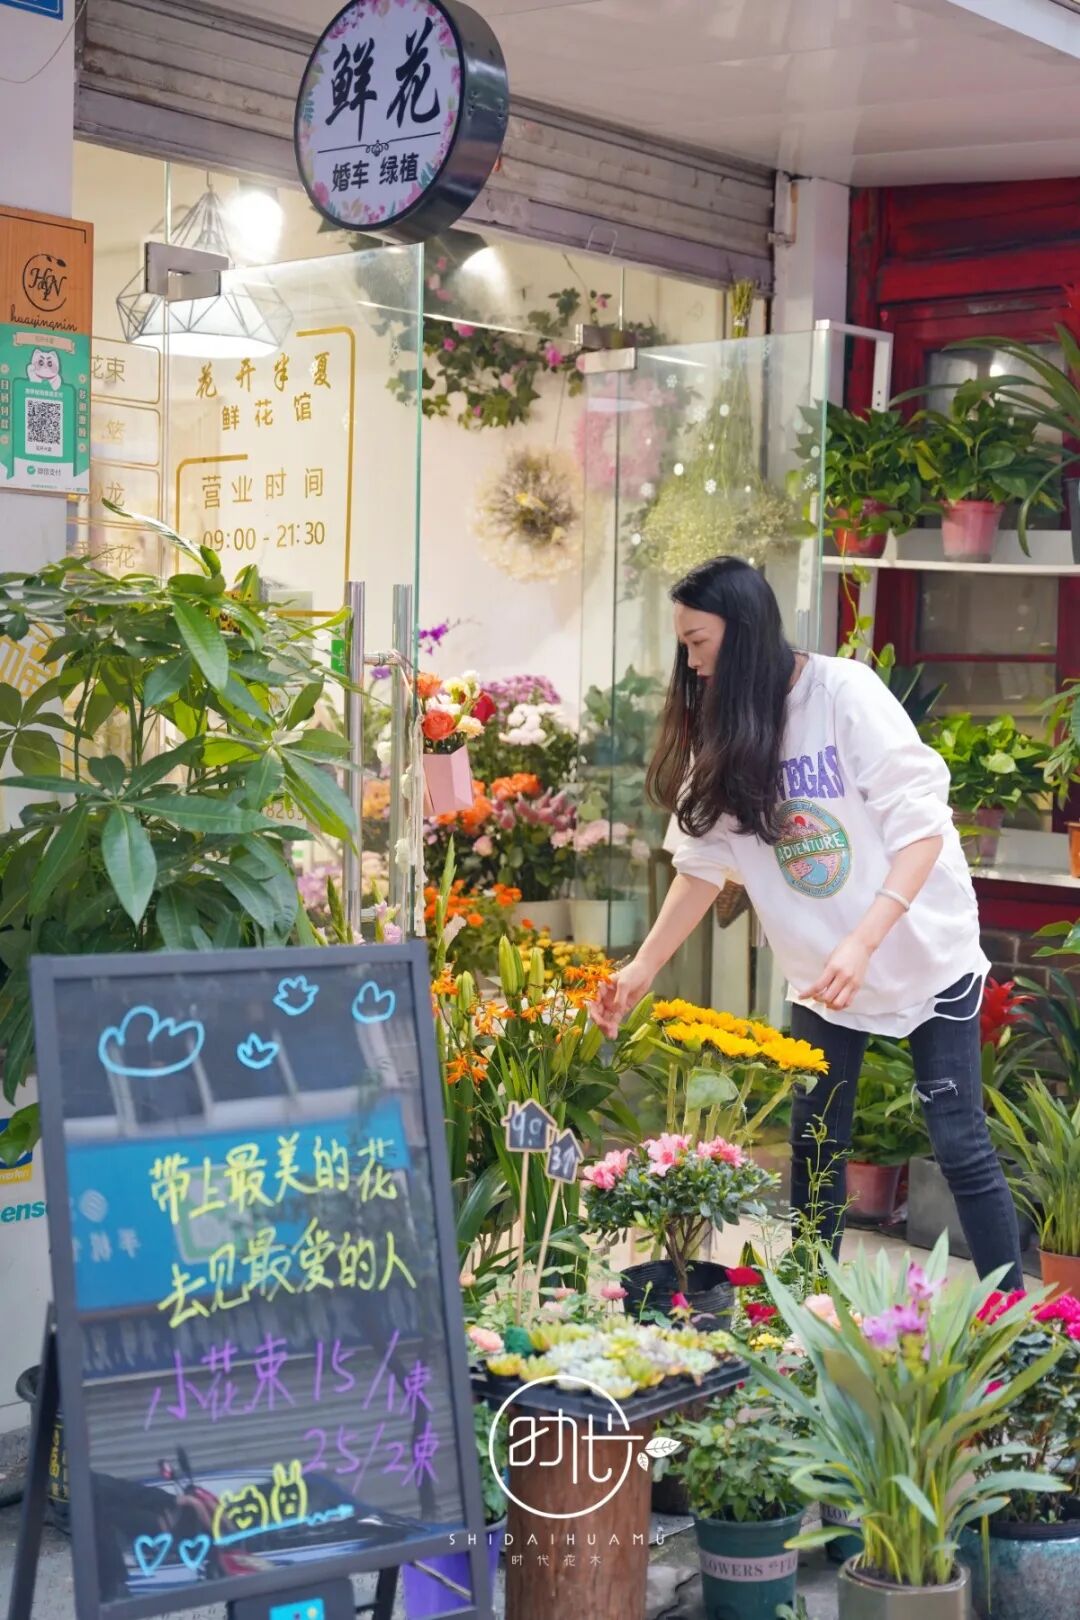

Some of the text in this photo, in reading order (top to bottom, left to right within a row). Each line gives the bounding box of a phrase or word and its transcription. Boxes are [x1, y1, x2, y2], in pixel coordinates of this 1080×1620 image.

[325, 16, 441, 142] 鲜花
[331, 152, 419, 192] 婚车 绿植
[196, 352, 332, 400] 花开半夏
[221, 392, 312, 431] 鲜花馆
[202, 467, 324, 509] 营业时间
[203, 527, 257, 553] 09:00
[276, 521, 325, 548] 21:30
[779, 831, 845, 862] ADVENTURE
[149, 1132, 398, 1225] 带上最美的花
[0, 1200, 47, 1223] ens
[157, 1216, 417, 1328] 去见最爱的人
